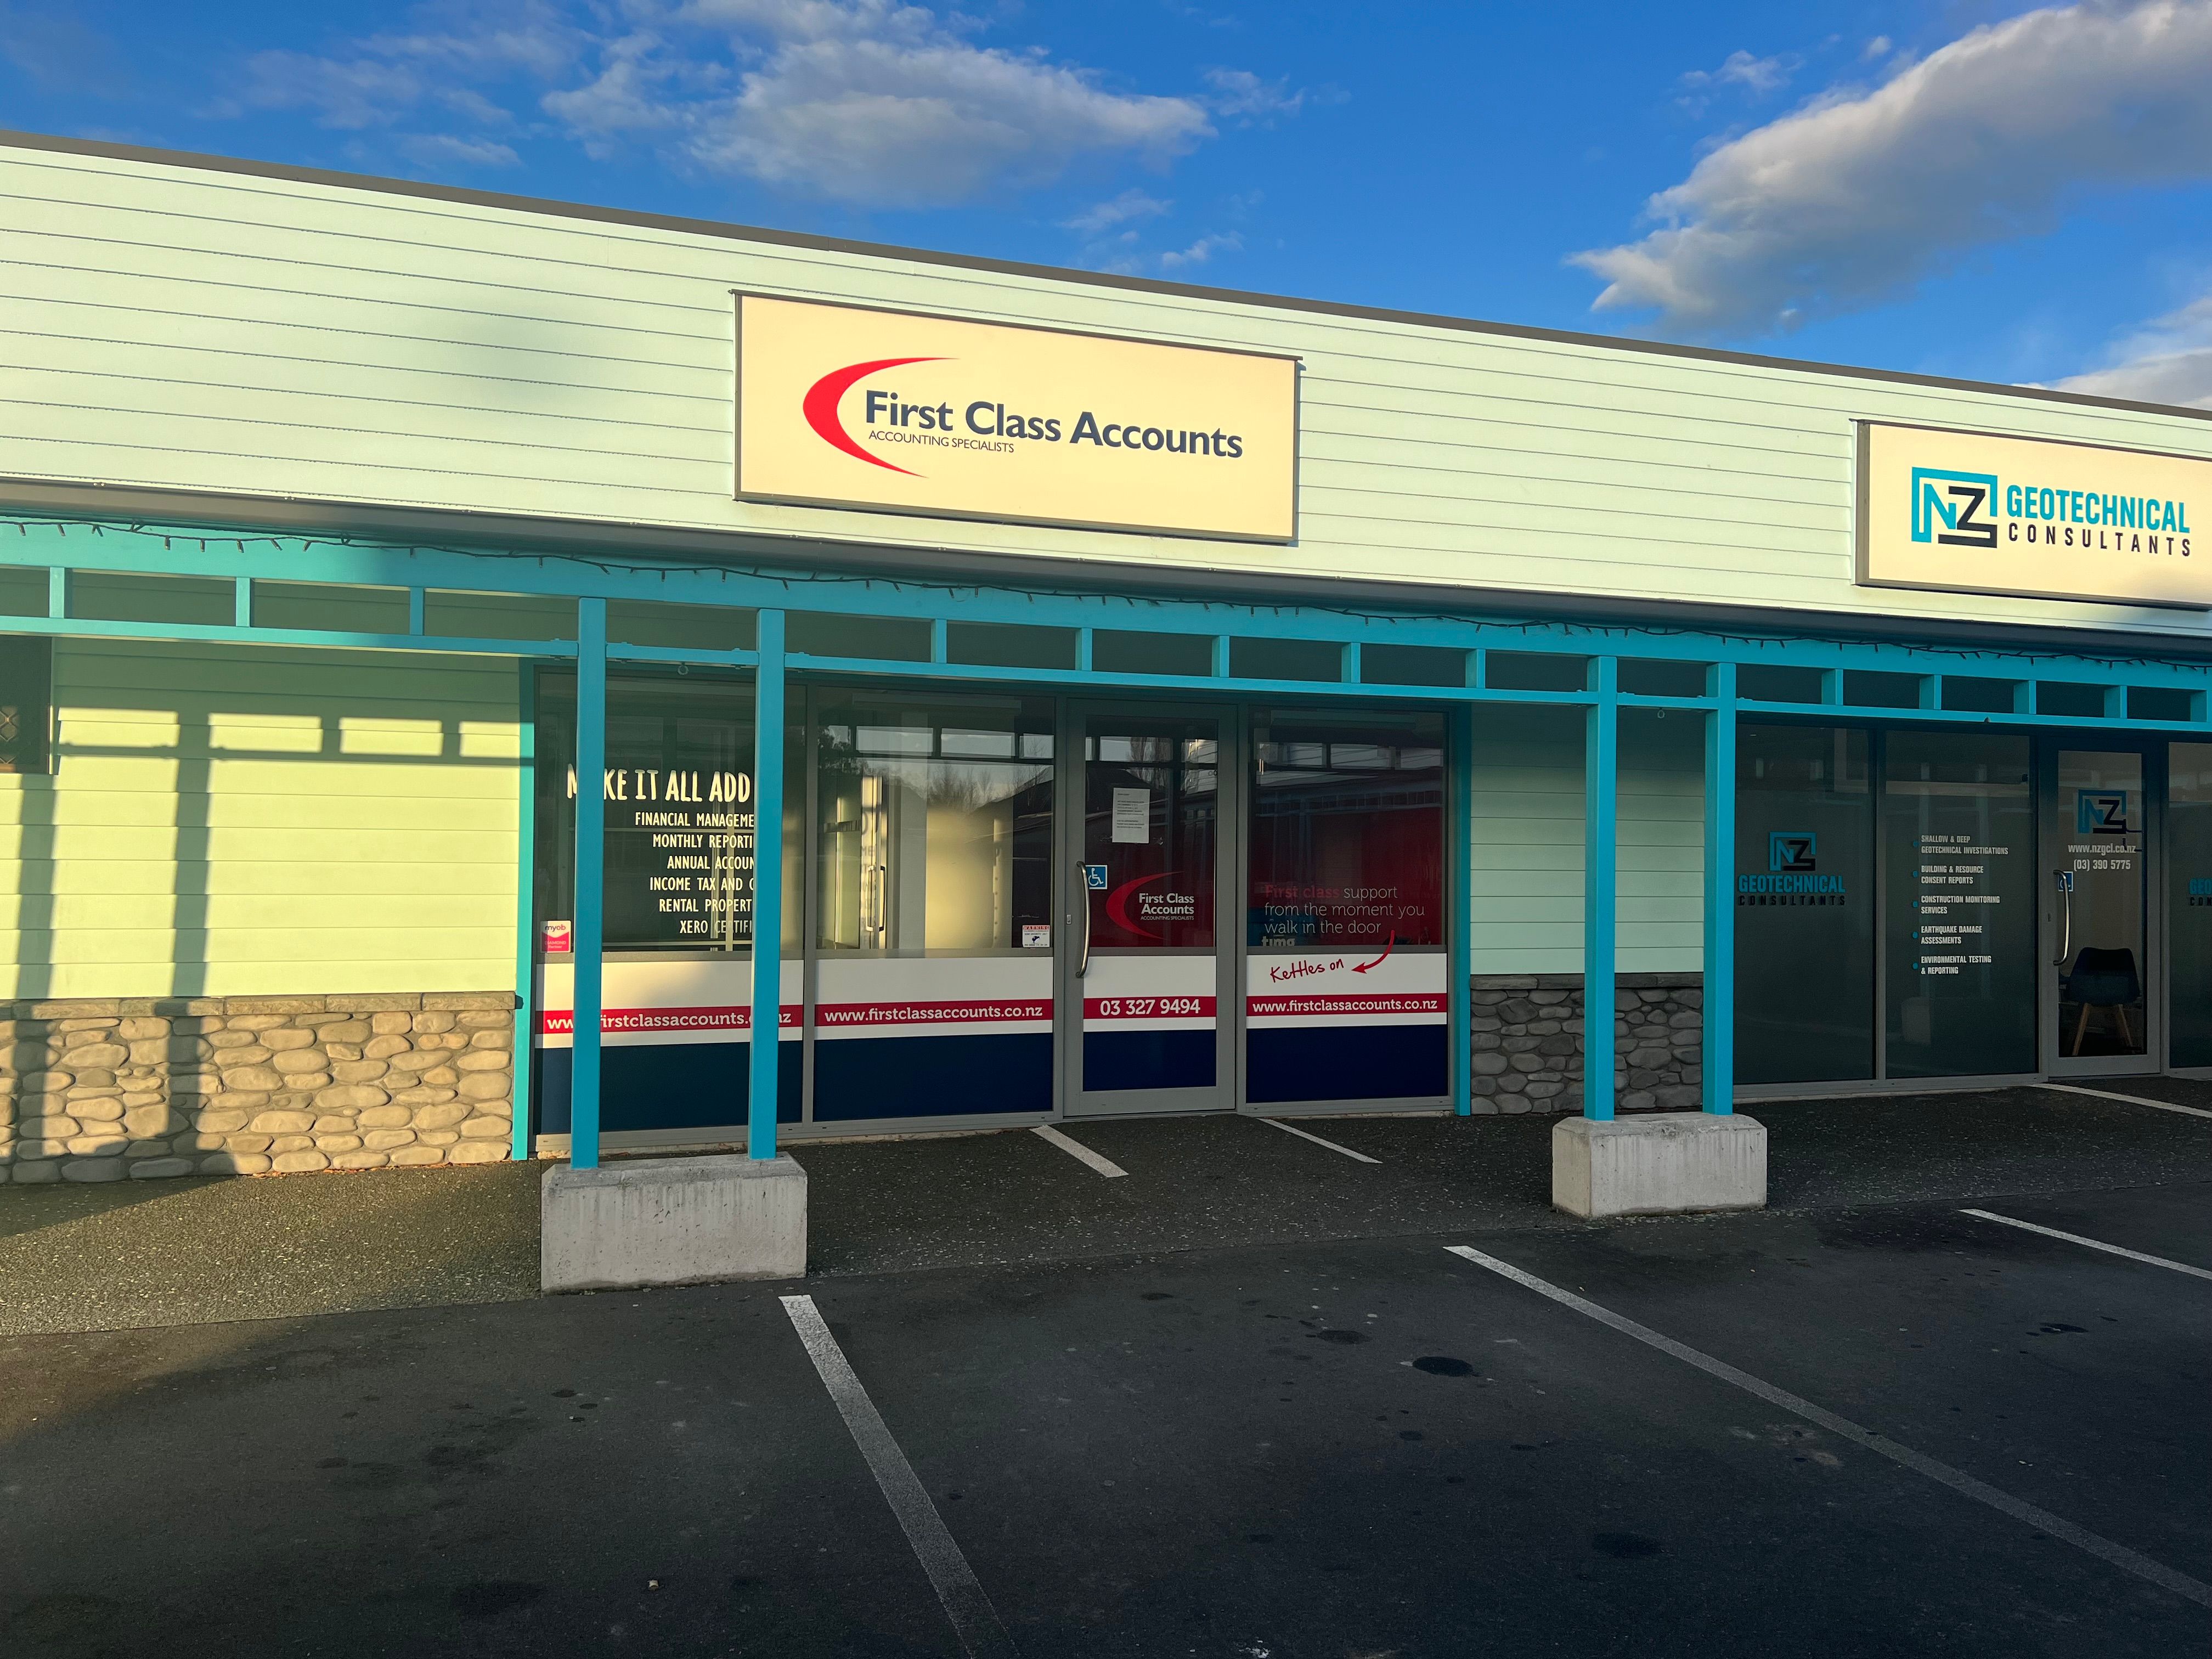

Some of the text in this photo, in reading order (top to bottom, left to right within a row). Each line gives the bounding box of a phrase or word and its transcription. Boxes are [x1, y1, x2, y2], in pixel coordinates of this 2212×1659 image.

[865, 390, 1243, 459] First Class Accounts
[868, 430, 1014, 454] ACCOUNTING SPECIALISTS
[1911, 467, 1997, 548] NZ
[2006, 485, 2190, 533] GEOTECHNICAL
[2008, 522, 2190, 557] CONSULTANTS
[567, 763, 751, 803] MKE IT ALL ADD
[635, 812, 754, 827] FINANCIAL MANAGEME
[653, 834, 753, 848] MONTHLY REPORTI
[667, 856, 754, 870] ANNUAL ACCOUN
[2073, 860, 2131, 872] (03) 390 5775
[650, 877, 691, 891] INCOME
[697, 877, 716, 891] TAX
[721, 877, 743, 891] AND
[1739, 874, 1846, 893] GEOTECHNICAL
[1139, 893, 1194, 904] First Class
[1264, 884, 1397, 901] First class support
[659, 899, 752, 912] RENTAL PROPERT
[1739, 895, 1845, 906] CONSULTANTS
[1141, 904, 1194, 915] Accounts
[1265, 902, 1425, 919] from the moment you
[545, 924, 566, 932] myob
[679, 920, 708, 934] XERO
[1265, 920, 1381, 934] walk in the door
[1921, 926, 1957, 935] EARTHQUAKE
[1269, 958, 1344, 983] Kettles on
[1100, 998, 1201, 1015] 03 327 9494
[1252, 998, 1437, 1013] www.firstclassaccounts.co.nz
[825, 1006, 1042, 1022] www.firstclassaccounts.co.nz
